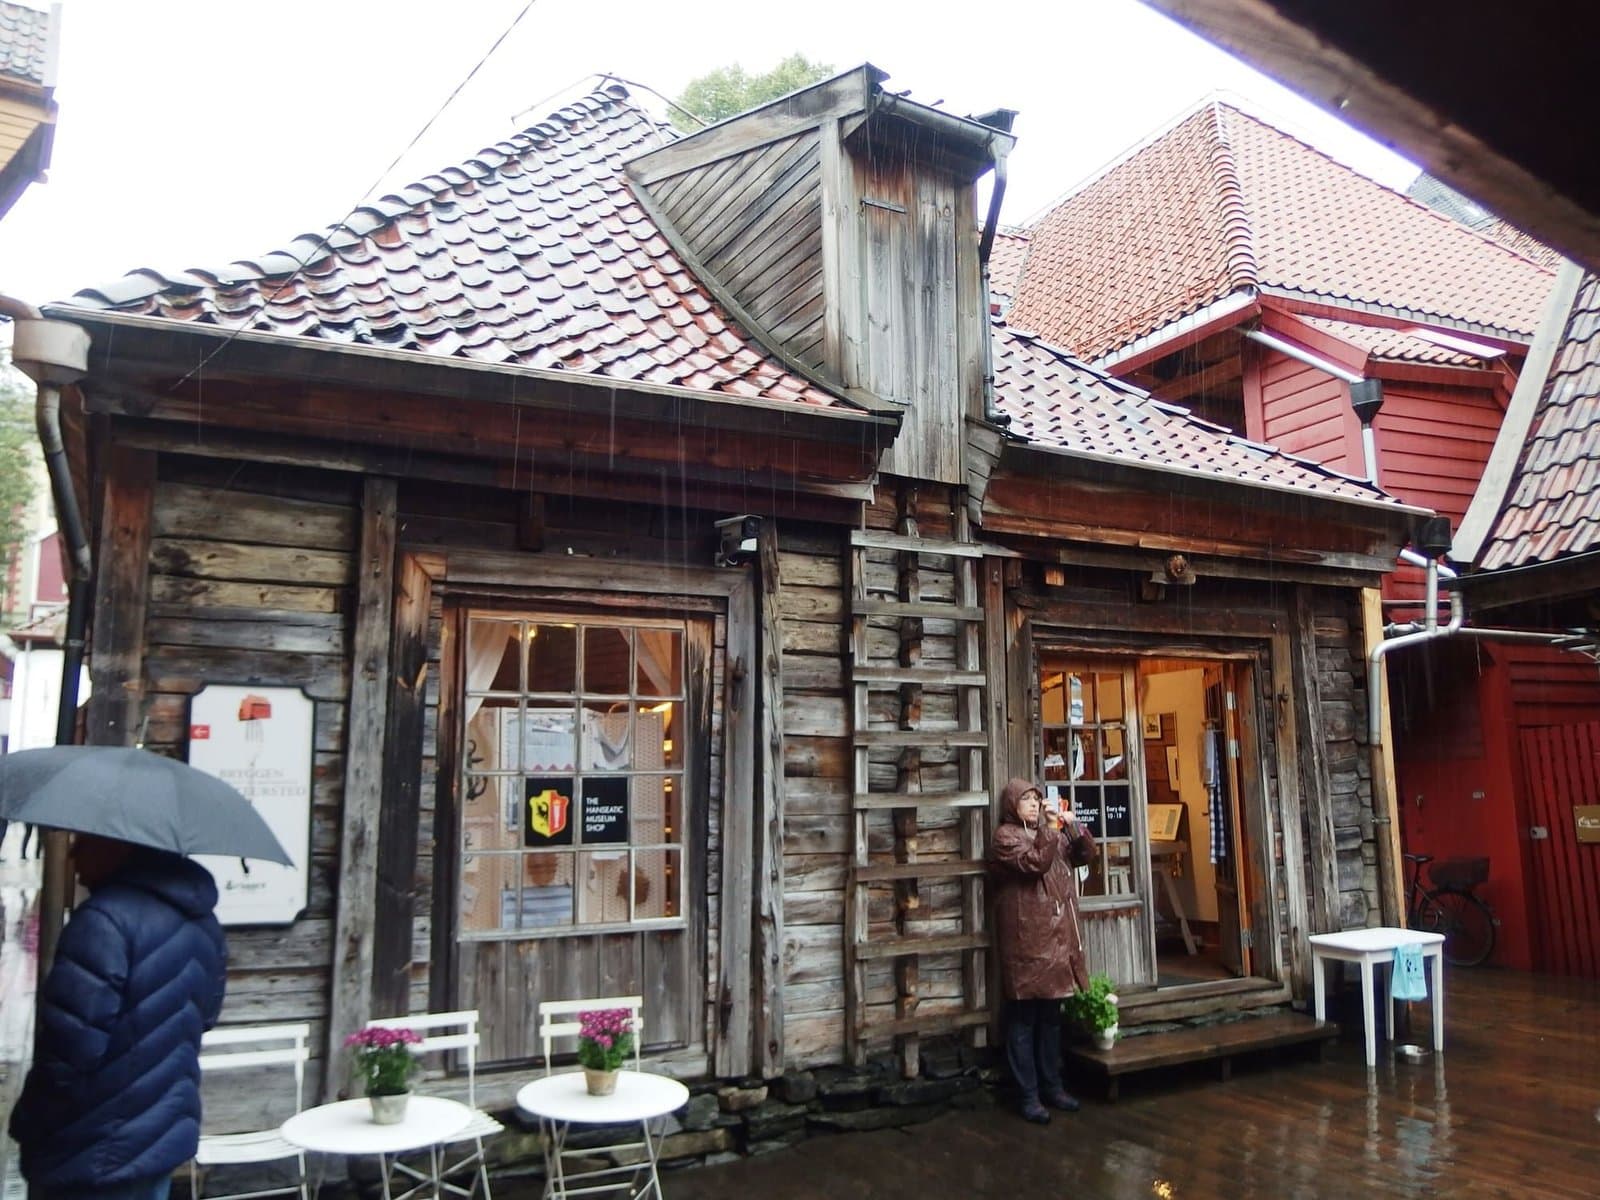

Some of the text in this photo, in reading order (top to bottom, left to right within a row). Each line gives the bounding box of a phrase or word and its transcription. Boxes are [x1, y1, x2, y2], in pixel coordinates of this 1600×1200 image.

[586, 797, 599, 805] THE
[586, 806, 624, 814] HANSEATIC
[586, 815, 616, 823] MUSEUM
[586, 824, 605, 832] SHOP
